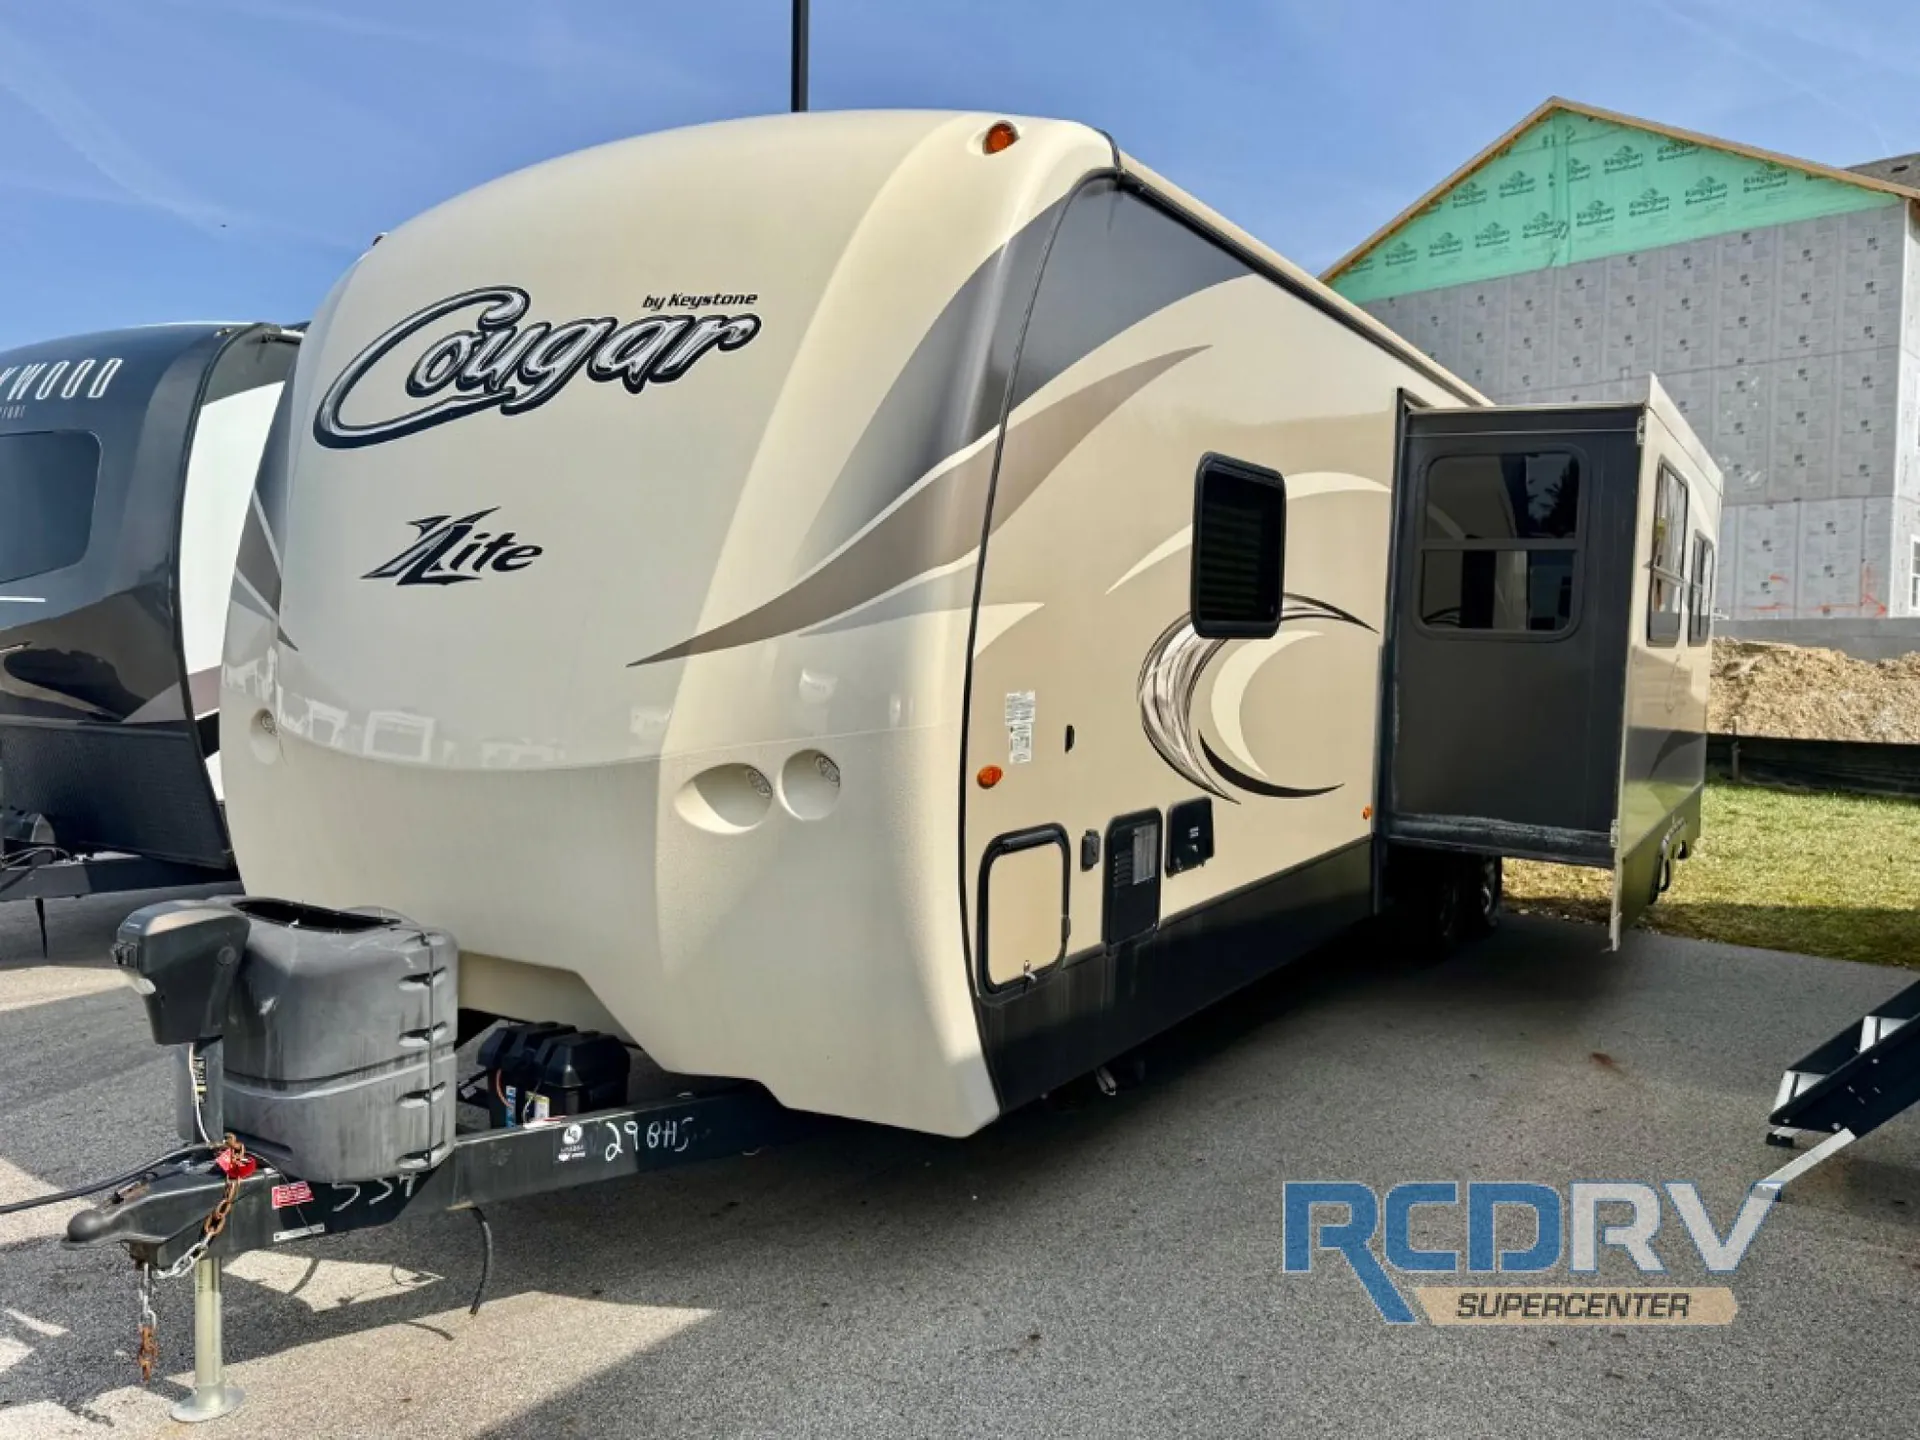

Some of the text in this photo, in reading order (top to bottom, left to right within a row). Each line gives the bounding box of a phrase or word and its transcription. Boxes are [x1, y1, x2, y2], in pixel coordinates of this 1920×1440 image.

[642, 292, 758, 311] by Keystone
[313, 285, 762, 449] Cougar
